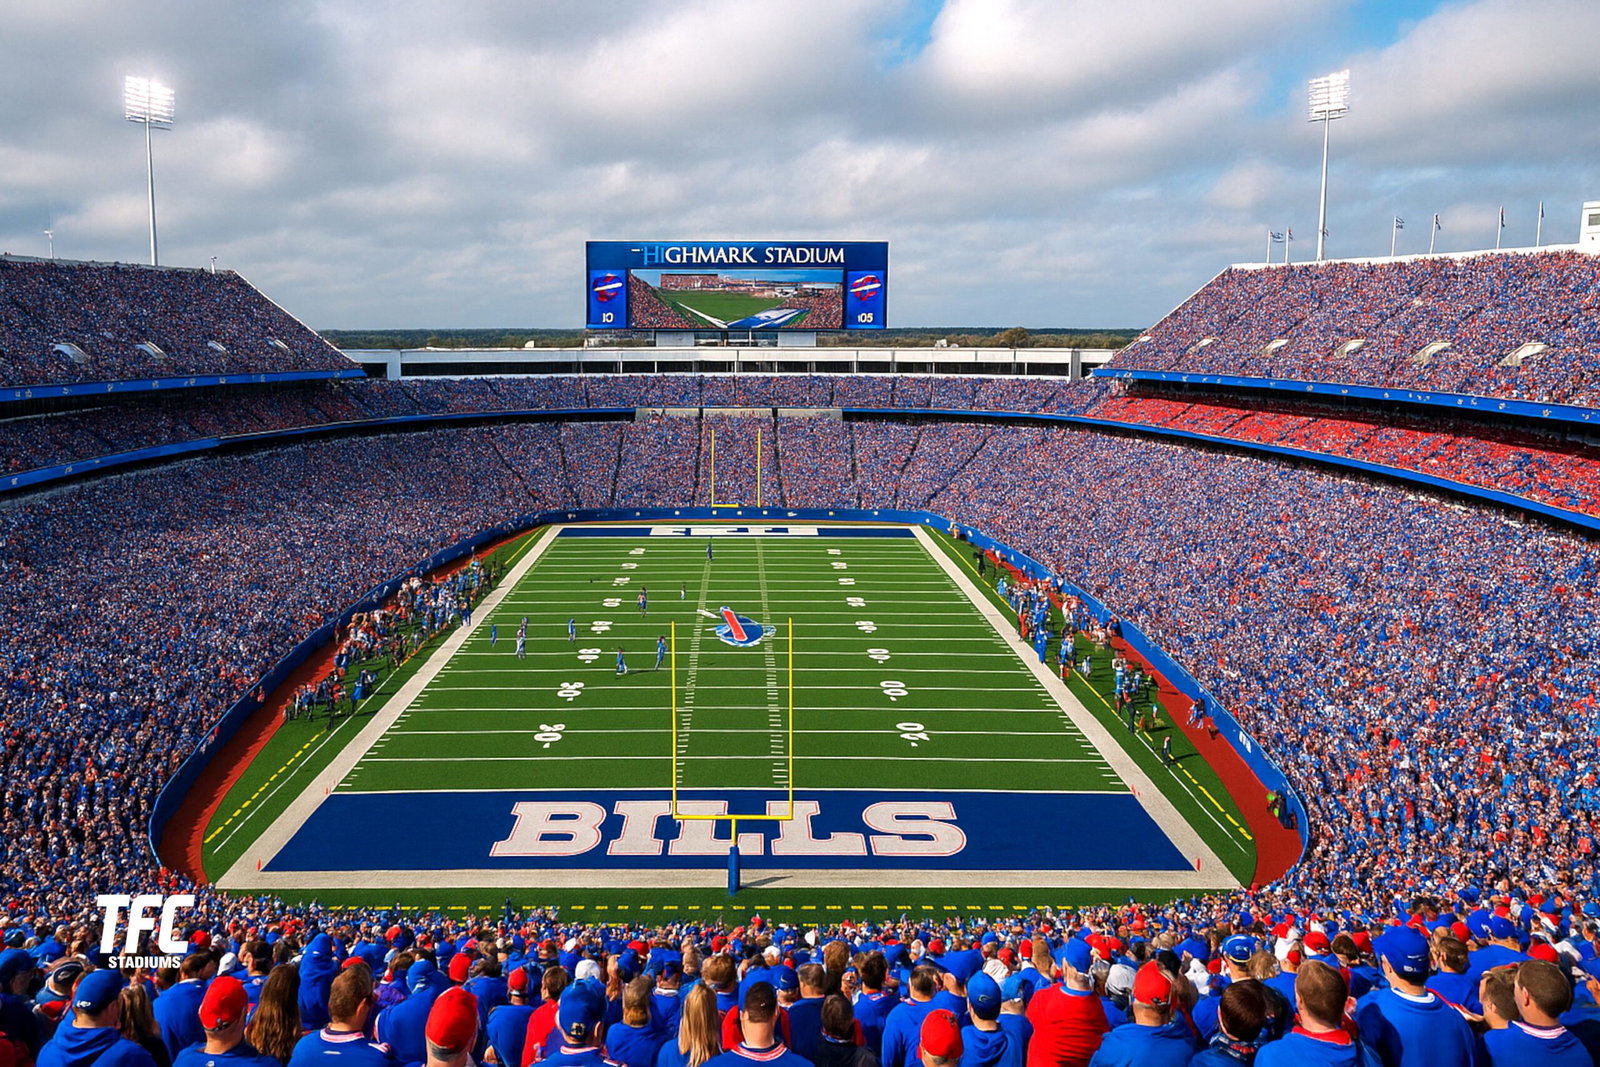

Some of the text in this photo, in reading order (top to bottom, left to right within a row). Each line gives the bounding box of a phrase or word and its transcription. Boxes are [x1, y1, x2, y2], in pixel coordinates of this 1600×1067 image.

[643, 246, 845, 265] HIGHMARK STADIUM
[489, 801, 967, 857] BILLS
